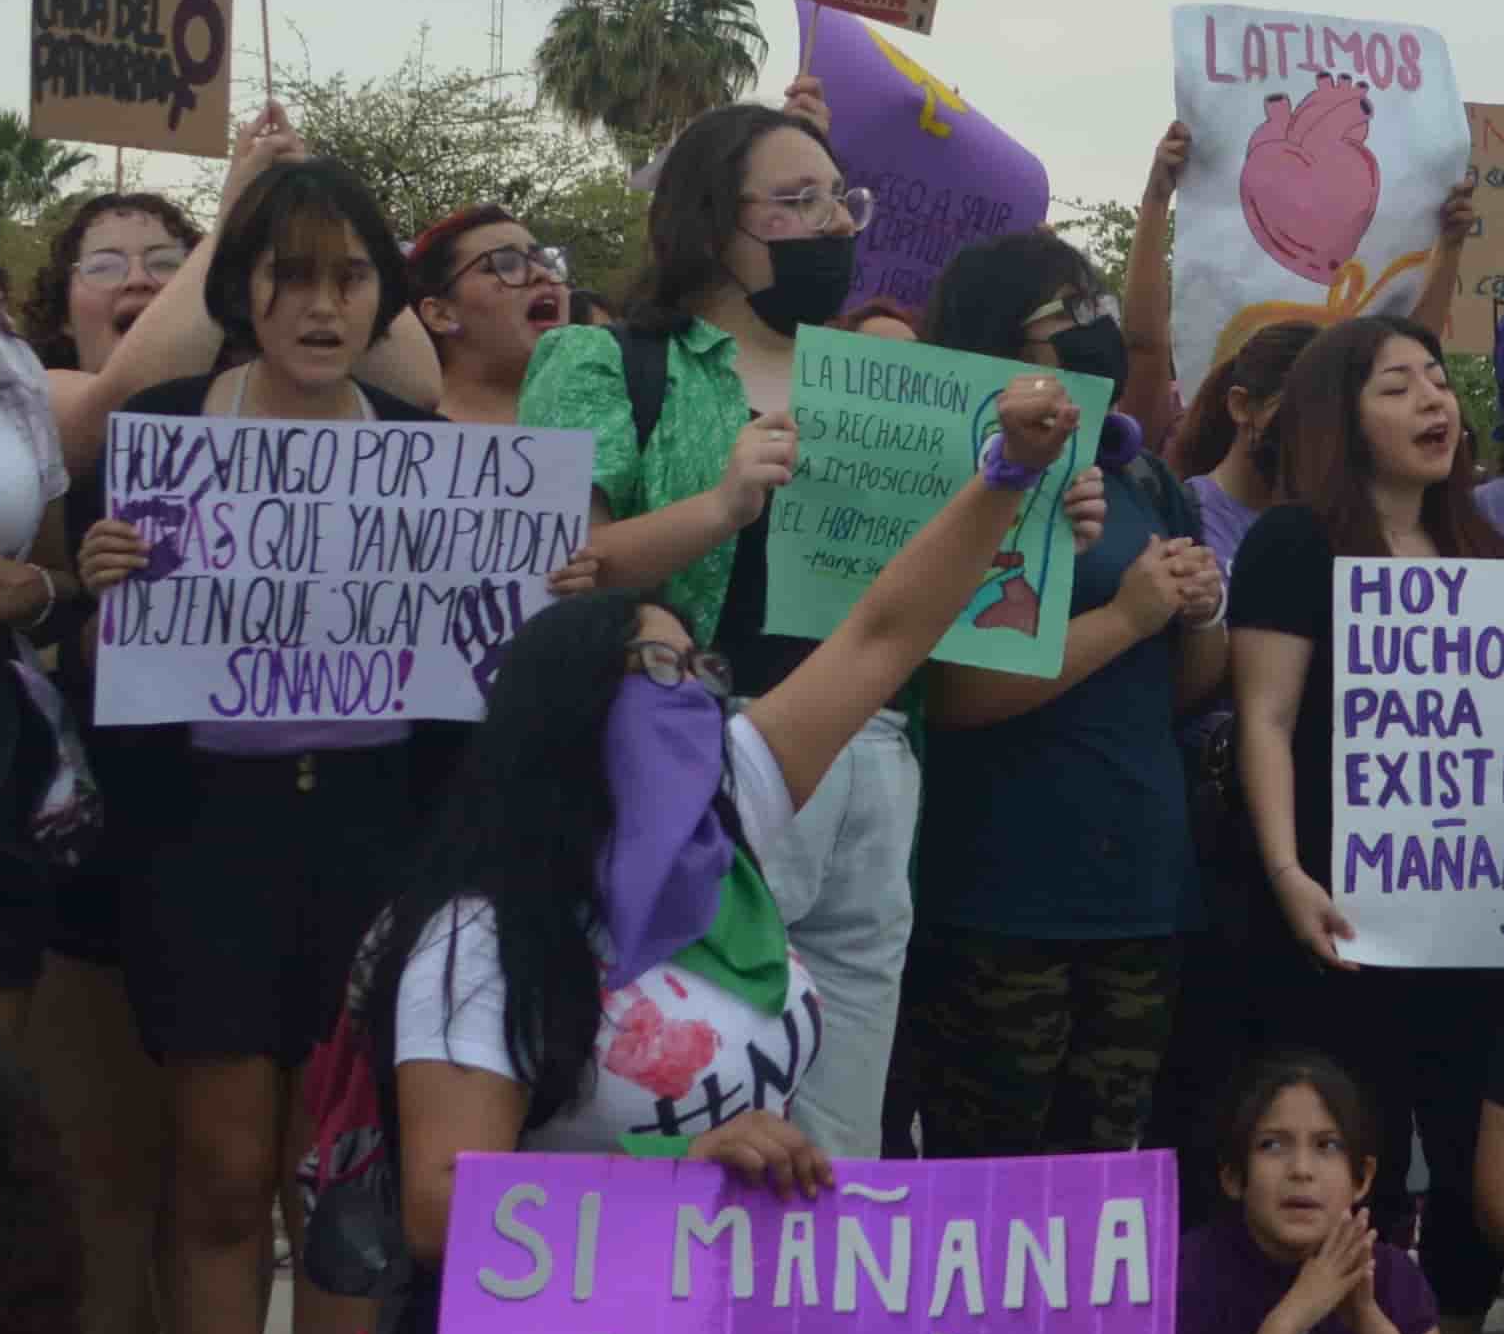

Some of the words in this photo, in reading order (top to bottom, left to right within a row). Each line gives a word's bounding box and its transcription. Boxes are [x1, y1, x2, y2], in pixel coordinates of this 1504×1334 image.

[801, 353, 832, 392] LA
[846, 358, 972, 414] LIBERACIÓN
[206, 428, 338, 494] VENGO
[349, 429, 434, 498] POR
[448, 434, 535, 498] LAS
[838, 413, 945, 454] RECHAZAR
[823, 456, 953, 499] IMPOSICIÓN
[248, 498, 333, 574] QUE
[448, 509, 581, 576] PUEDEN
[241, 578, 312, 648] QUE
[1350, 566, 1467, 615] HOY
[1344, 688, 1483, 738] PARA
[477, 1184, 602, 1300] SI
[671, 1183, 1153, 1317] MAÑANA
